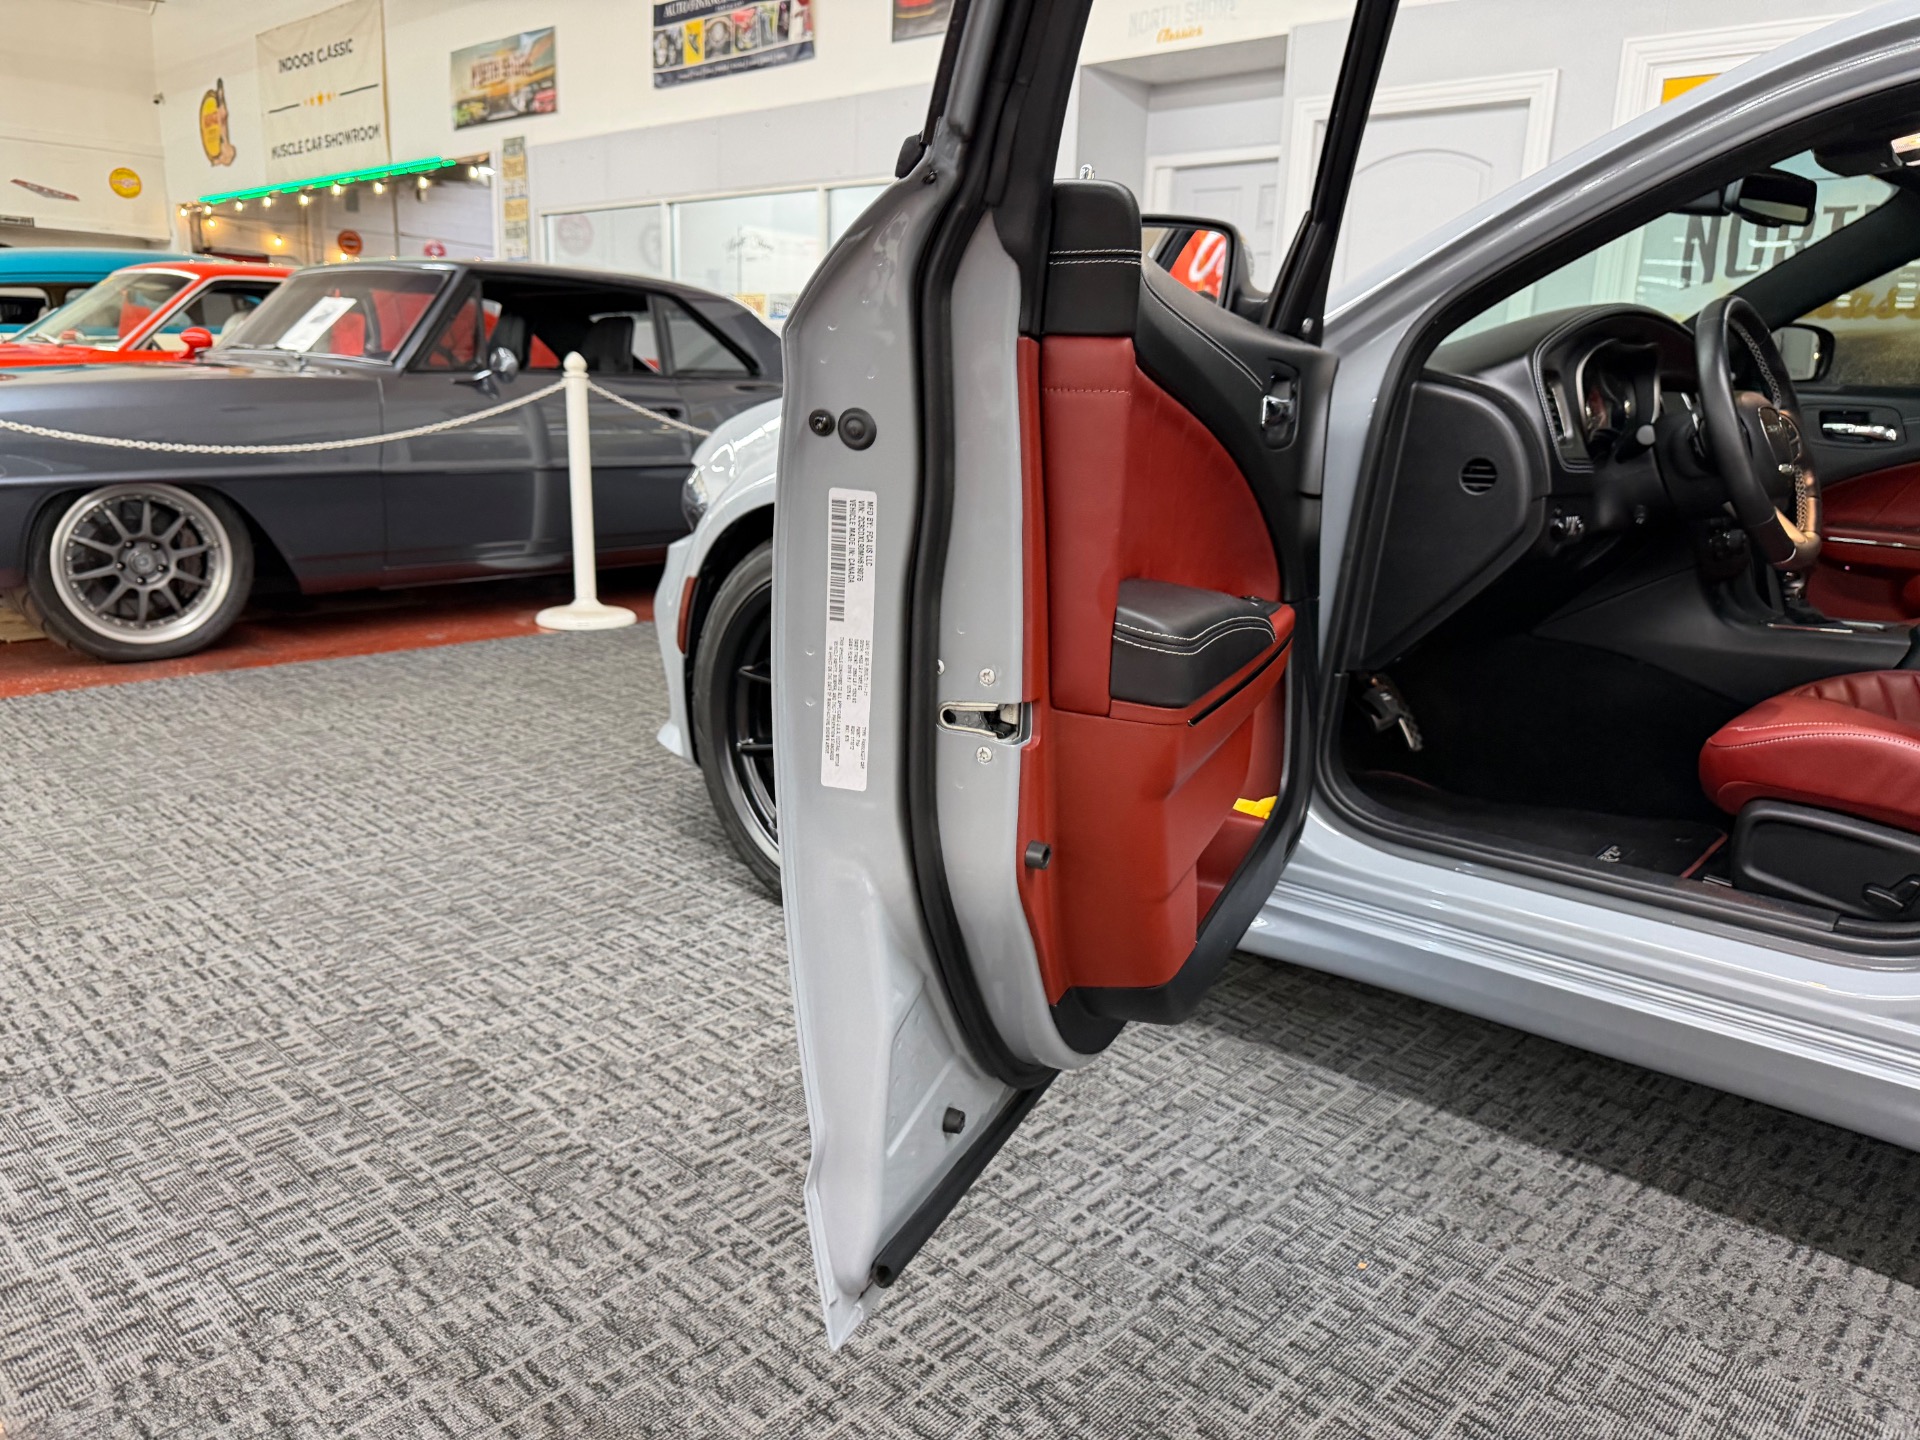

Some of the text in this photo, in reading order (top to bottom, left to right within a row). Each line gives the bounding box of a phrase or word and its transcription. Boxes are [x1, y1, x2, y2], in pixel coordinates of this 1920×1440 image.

[278, 38, 353, 74] INDOOR CLASSIC
[271, 123, 381, 160] MUSCLE CAR SHOWROOM
[866, 545, 873, 553] US
